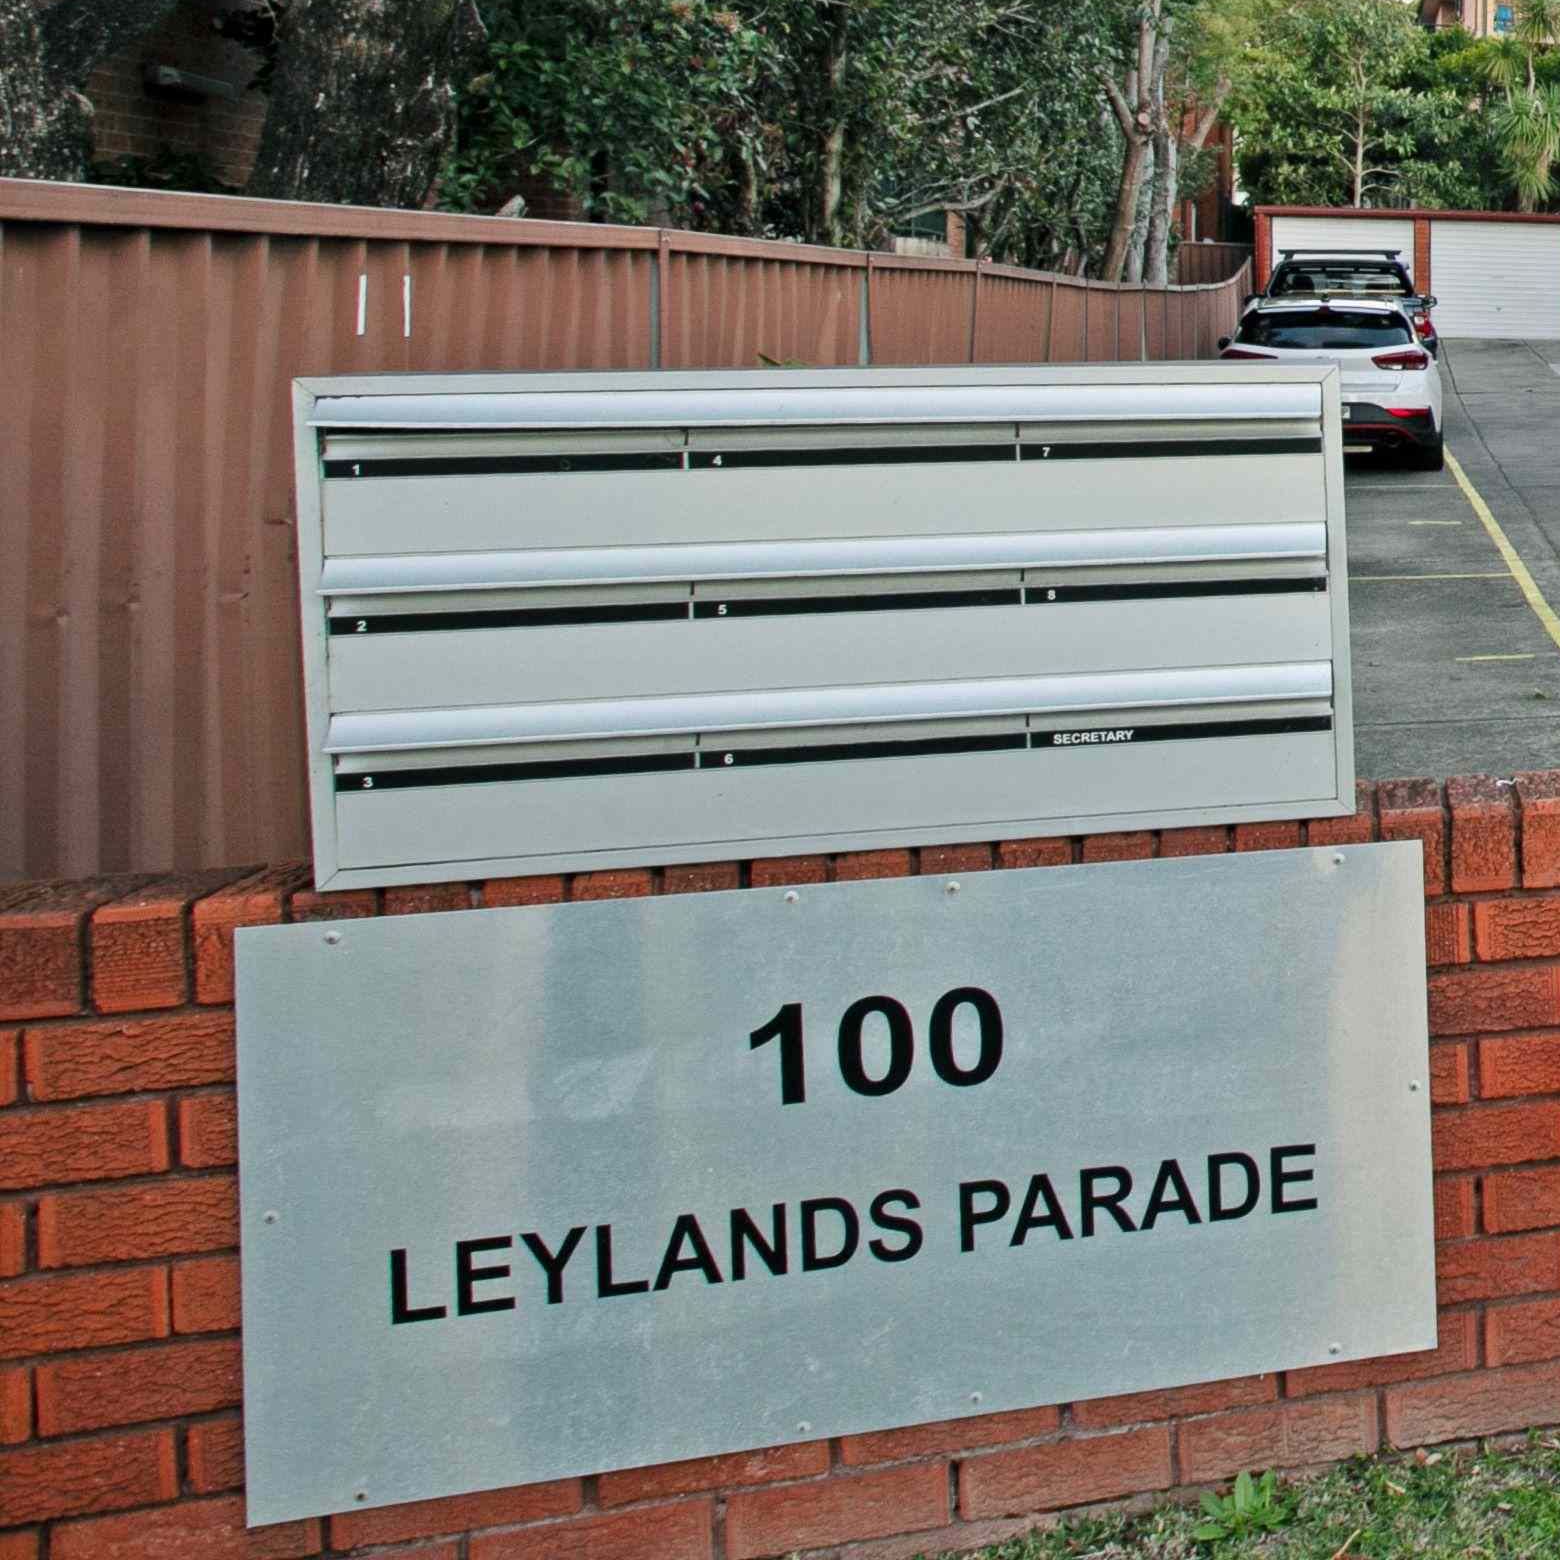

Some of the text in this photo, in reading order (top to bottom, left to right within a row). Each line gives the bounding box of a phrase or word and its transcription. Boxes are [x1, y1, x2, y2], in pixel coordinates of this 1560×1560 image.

[1041, 446, 1051, 458] 7
[711, 454, 723, 466] 4
[351, 463, 361, 476] 1
[1047, 588, 1057, 601] 8
[717, 603, 728, 615] 5
[356, 620, 367, 632] 2
[1052, 729, 1135, 745] SECRETARY
[723, 753, 734, 765] 6
[363, 776, 374, 788] 3
[749, 986, 1004, 1106] 100
[389, 1142, 1319, 1326] LEYLANDS PARADE
